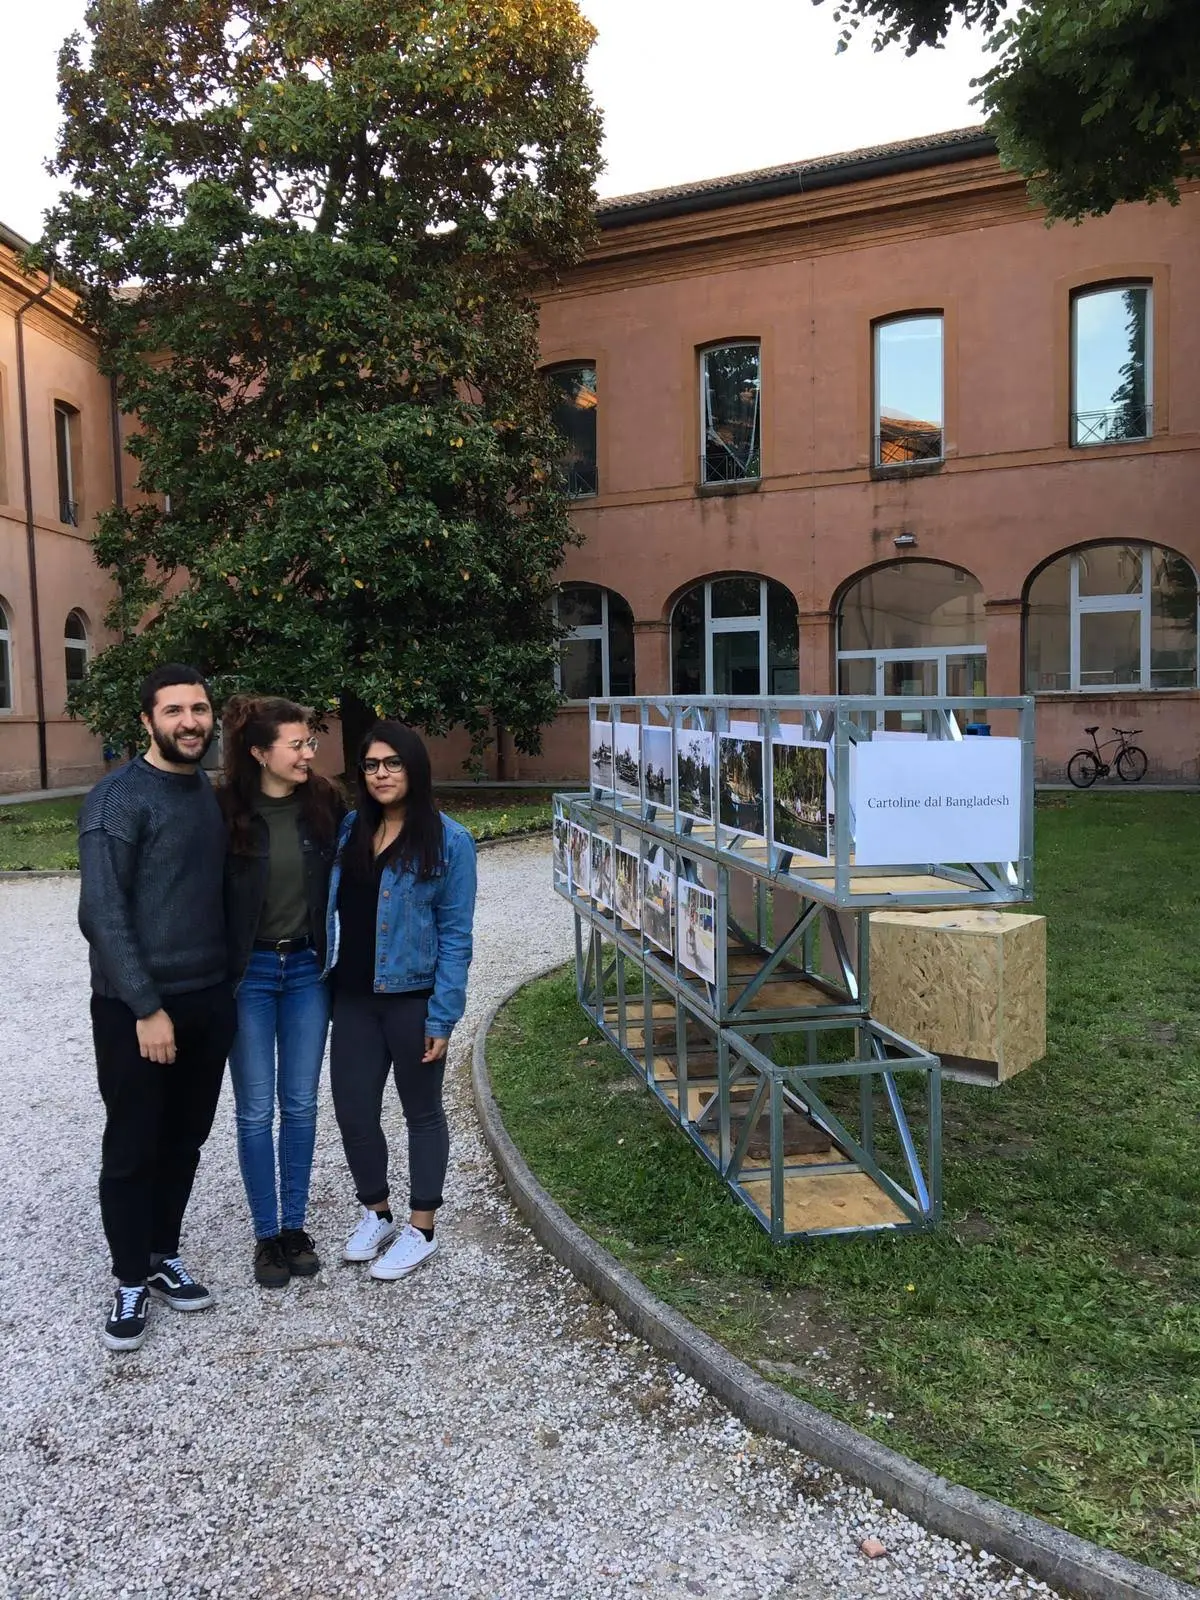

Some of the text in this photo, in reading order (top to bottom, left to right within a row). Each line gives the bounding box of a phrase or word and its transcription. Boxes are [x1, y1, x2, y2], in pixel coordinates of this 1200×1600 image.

[868, 795, 1010, 809] Cartoline dal Bangladesh
